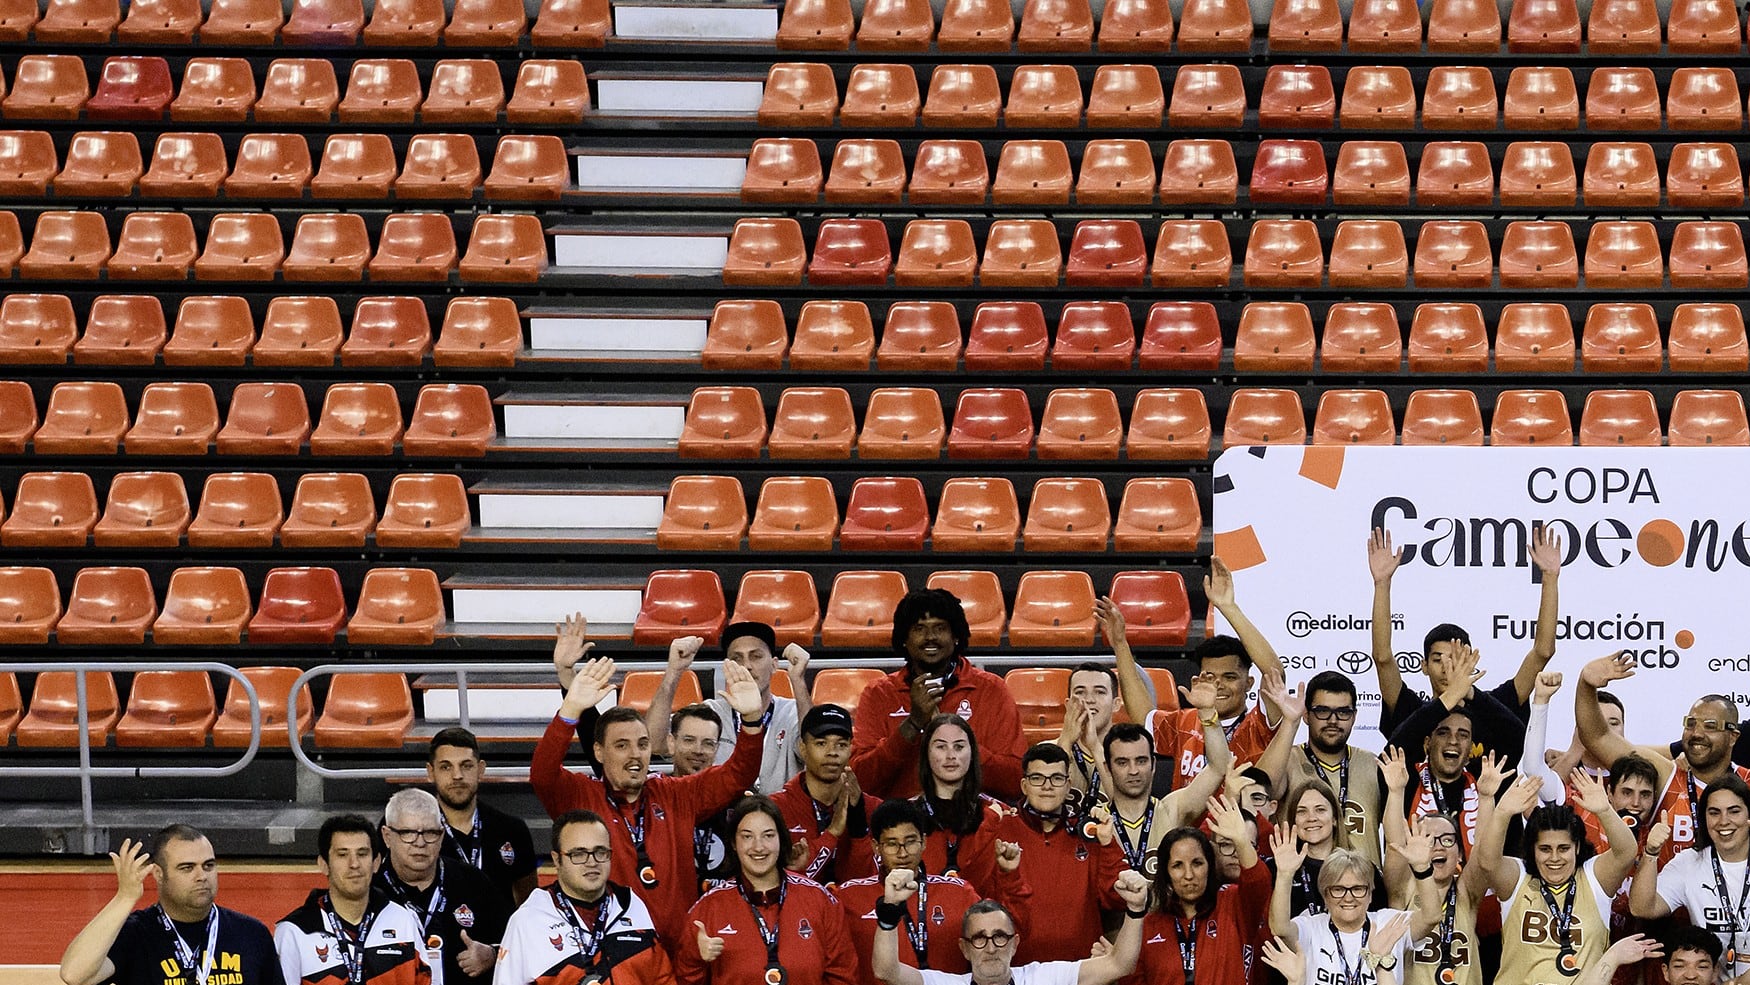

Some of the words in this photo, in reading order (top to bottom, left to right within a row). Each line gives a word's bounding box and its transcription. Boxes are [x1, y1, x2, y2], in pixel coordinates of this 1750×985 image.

[1527, 466, 1661, 504] COPA
[1289, 613, 1405, 634] mediolanm
[1180, 750, 1205, 778] BA
[1521, 908, 1584, 947] BG
[160, 950, 242, 978] UAM
